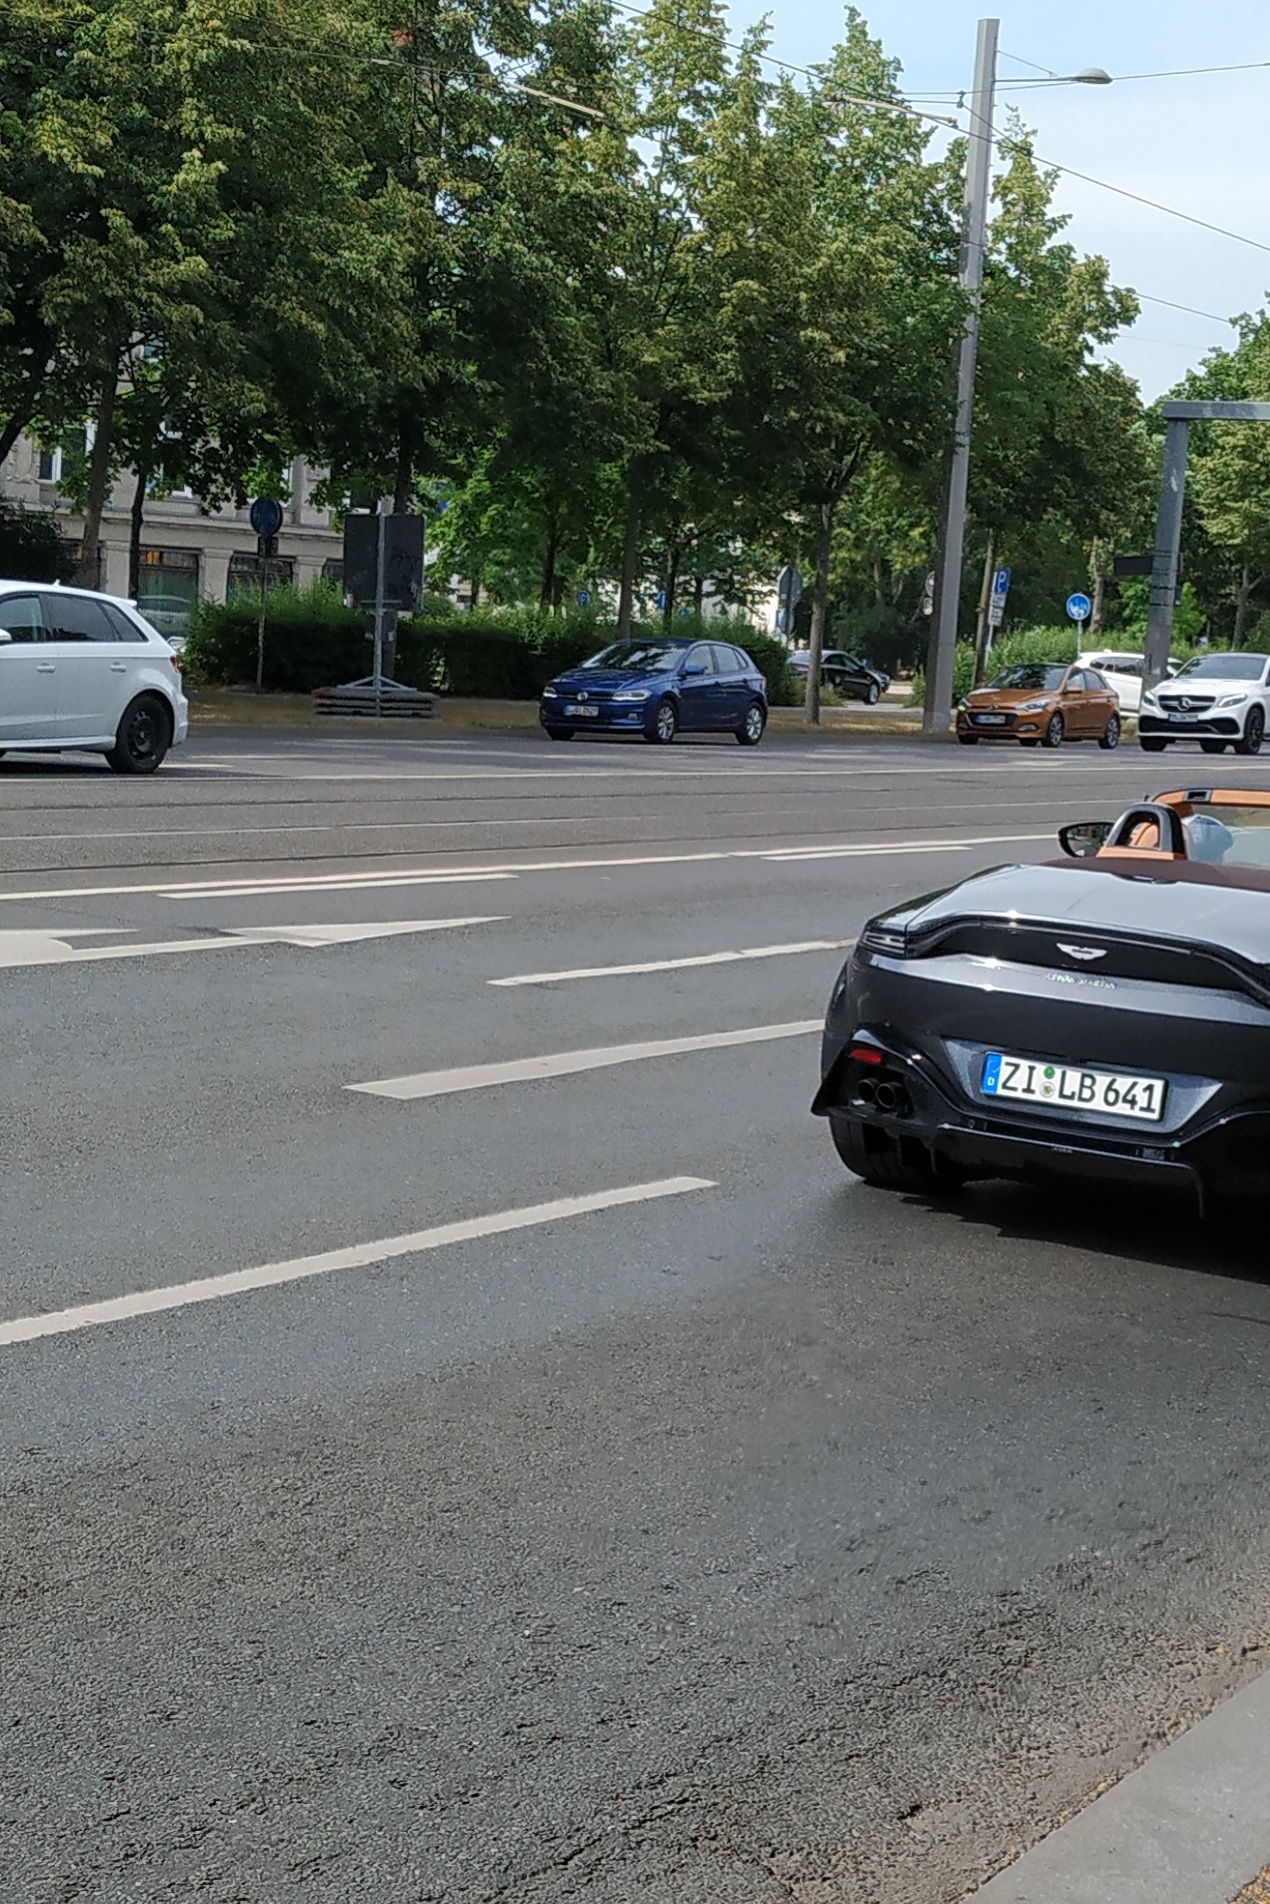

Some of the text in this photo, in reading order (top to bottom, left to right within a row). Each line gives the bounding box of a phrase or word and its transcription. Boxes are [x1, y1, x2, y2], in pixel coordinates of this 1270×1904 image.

[1001, 1061, 1037, 1095] ZI
[1058, 1069, 1097, 1103] LB
[1103, 1077, 1157, 1114] 641
